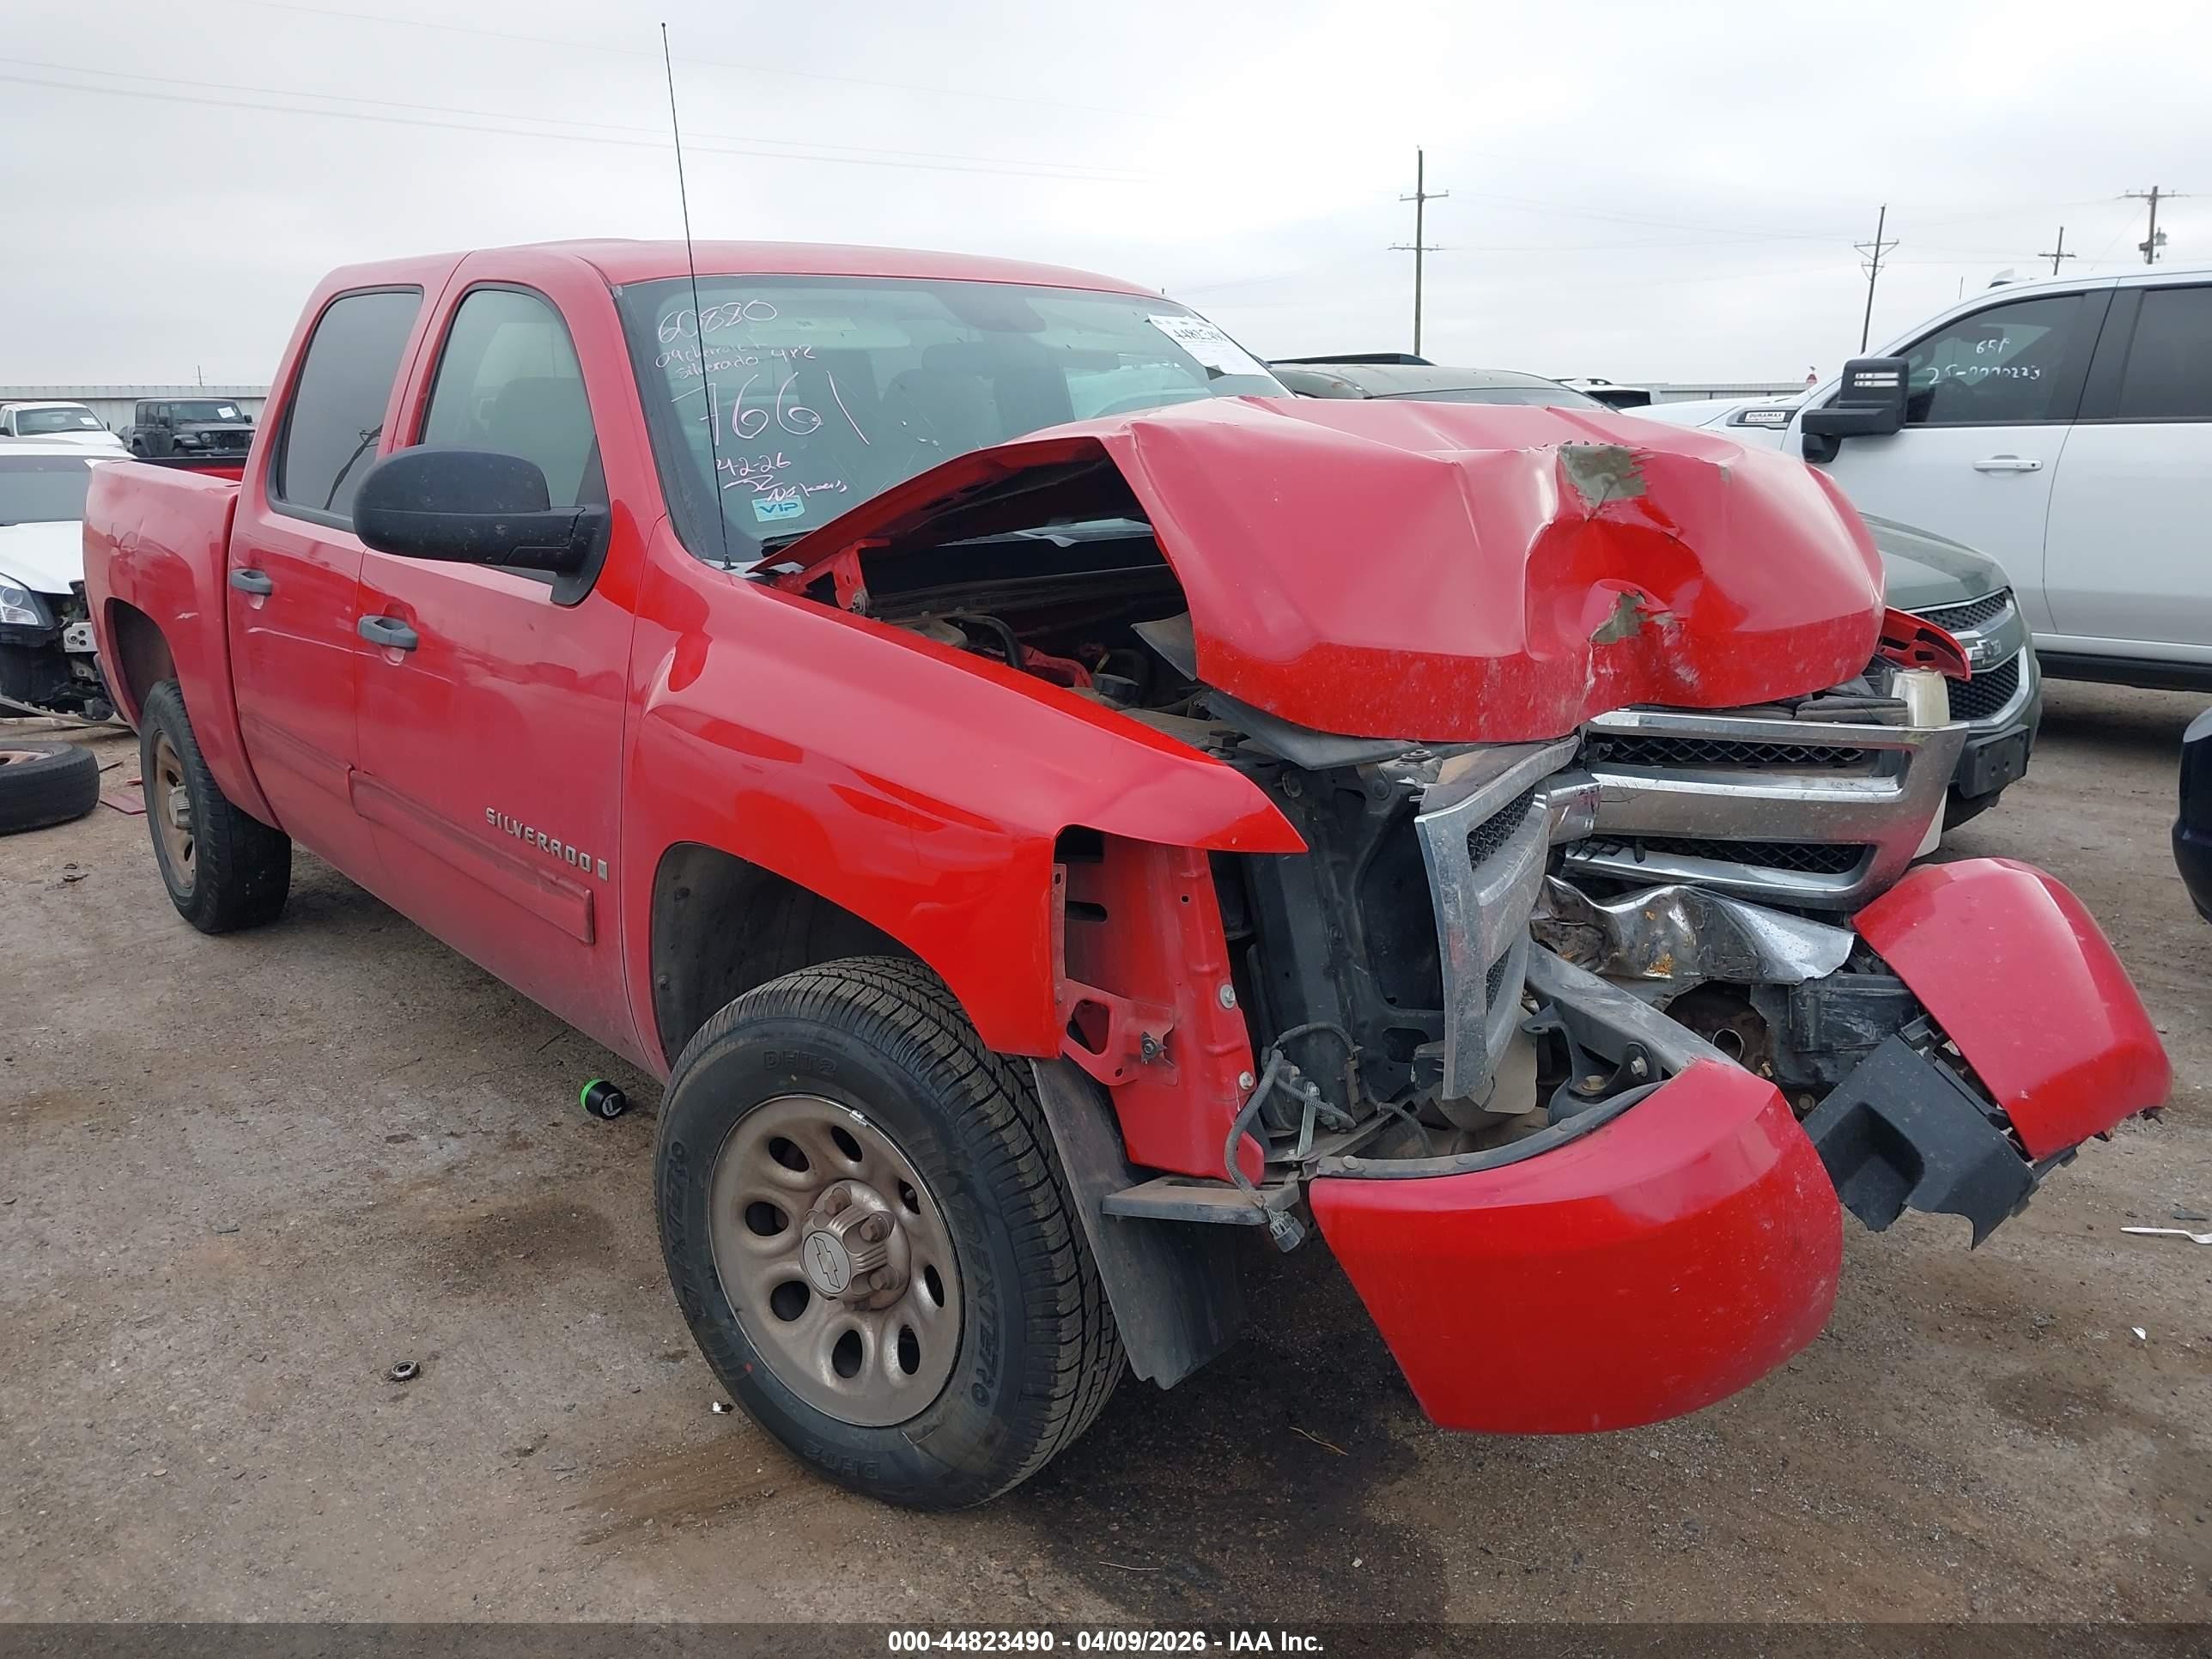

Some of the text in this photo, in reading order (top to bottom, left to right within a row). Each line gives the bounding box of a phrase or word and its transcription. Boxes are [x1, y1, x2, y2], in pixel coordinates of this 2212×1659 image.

[659, 300, 777, 343] 60880
[655, 349, 684, 368] 09
[671, 370, 871, 446] 7661
[485, 806, 592, 873] SILVERADO
